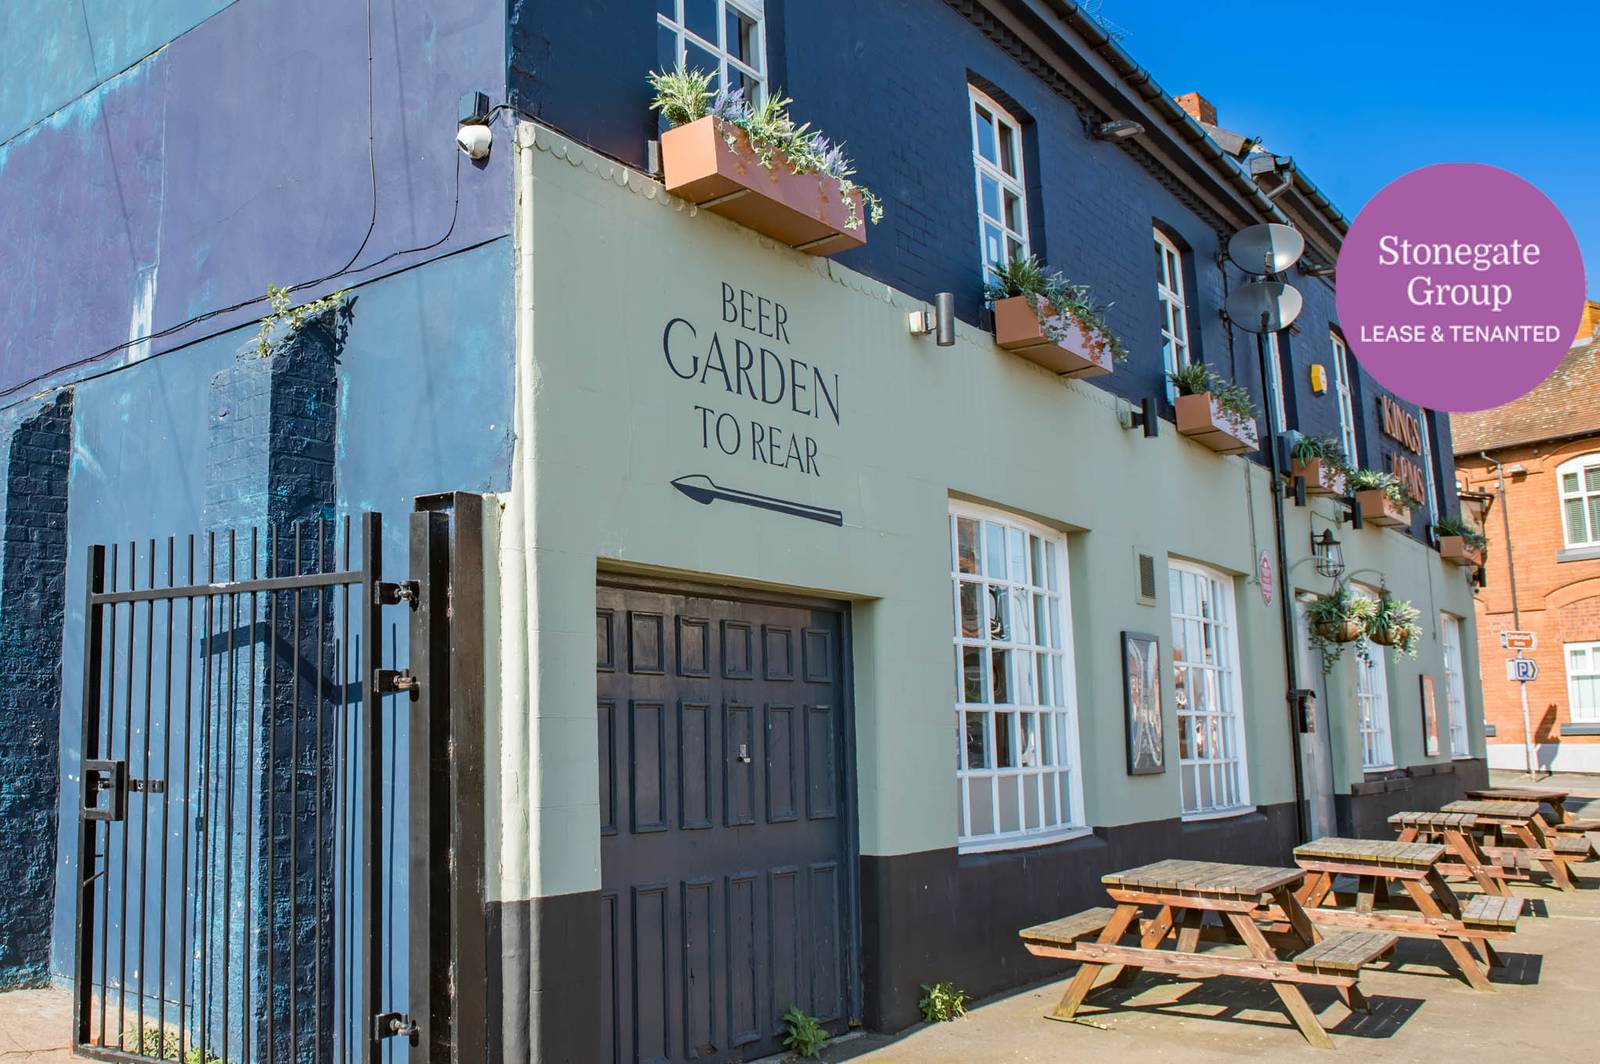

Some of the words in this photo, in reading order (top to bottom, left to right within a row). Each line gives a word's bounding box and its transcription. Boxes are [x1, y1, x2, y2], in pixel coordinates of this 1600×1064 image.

[721, 281, 791, 345] BEER
[663, 317, 840, 427] GARDEN
[694, 404, 741, 456] TO
[751, 420, 820, 477] REAR
[1381, 394, 1421, 456] KINGS
